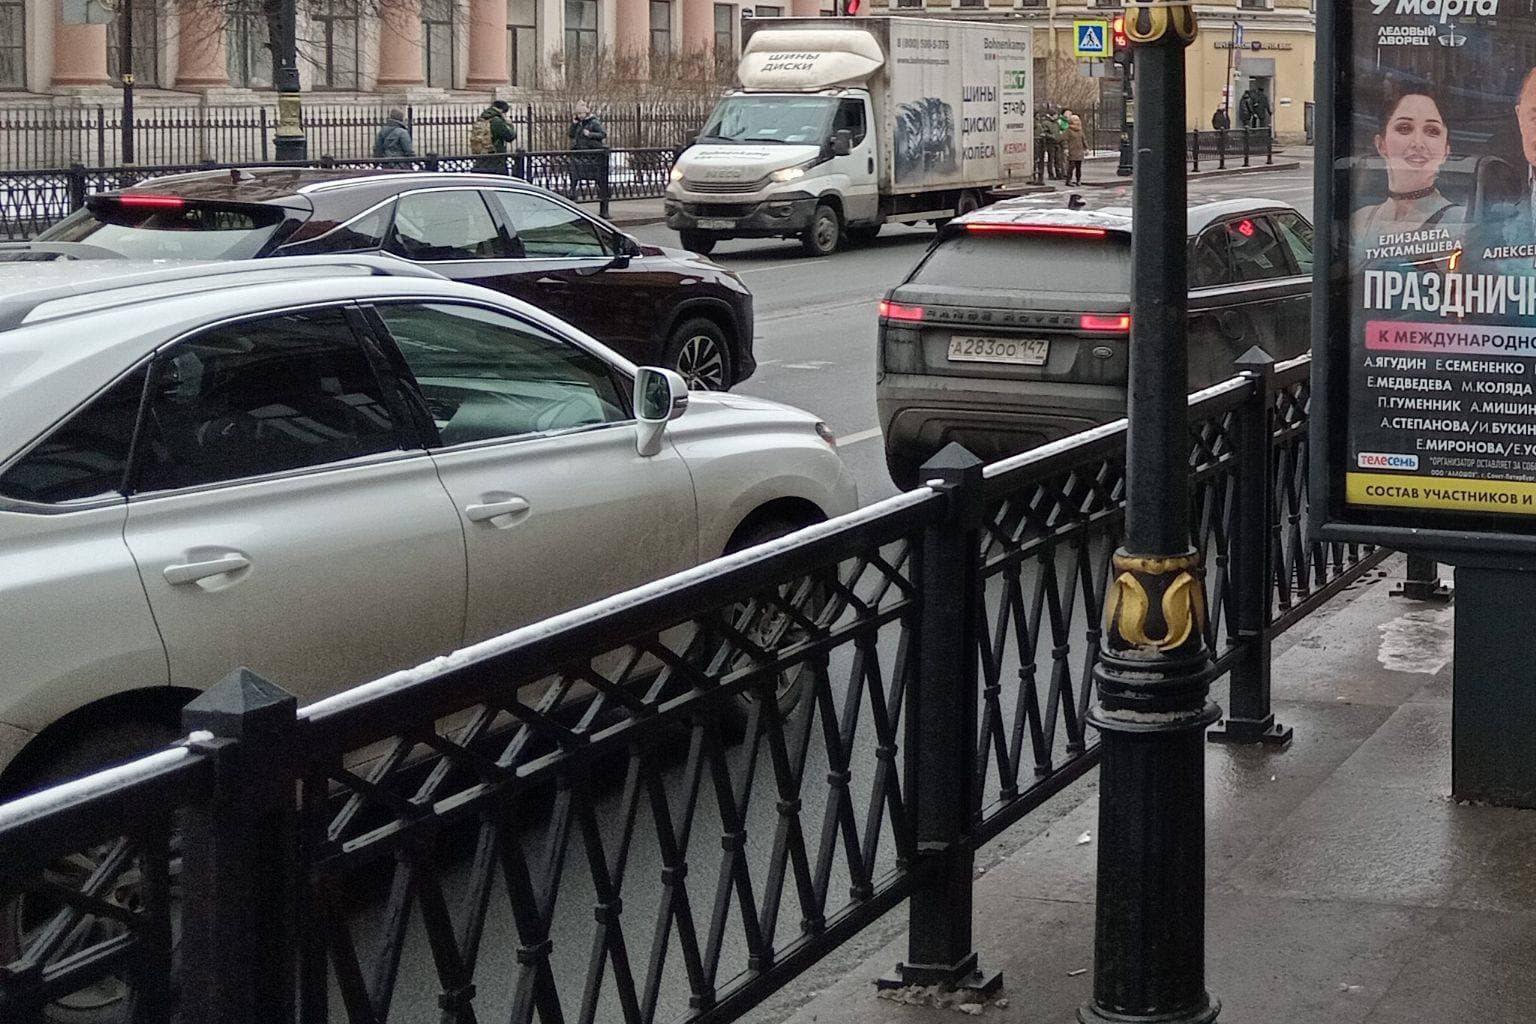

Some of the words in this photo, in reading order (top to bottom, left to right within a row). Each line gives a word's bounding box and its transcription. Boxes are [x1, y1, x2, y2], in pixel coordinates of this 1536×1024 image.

[1377, 25, 1437, 36] ЛЕДОВЫЙ
[1377, 36, 1430, 46] ДВОРЕЦ
[768, 53, 820, 62] ШИНЫ
[760, 62, 815, 73] ДИСКИ
[962, 85, 997, 103] ШИНЫ
[962, 116, 997, 136] ДИСКИ
[1378, 228, 1451, 246] ЕЛИЗАВЕТА
[1365, 239, 1463, 260] ТУКТАМЫШЕВА
[1378, 330, 1390, 343] К
[1020, 340, 1044, 354] 147
[1363, 356, 1427, 371] А.ЯГУДИН
[1435, 359, 1525, 375] Е.СЕМЕНЕНКО
[1366, 375, 1453, 392] Е.МЕДВЕДЕВА
[1461, 381, 1534, 397] М.КОЛЯДА
[1377, 396, 1462, 413] П.ГУМЕННИК
[1360, 455, 1417, 468] телесемь
[1365, 485, 1420, 499] СОСТАВ
[1423, 488, 1519, 505] УЧАСТНИКОВ
[1522, 494, 1533, 506] И
